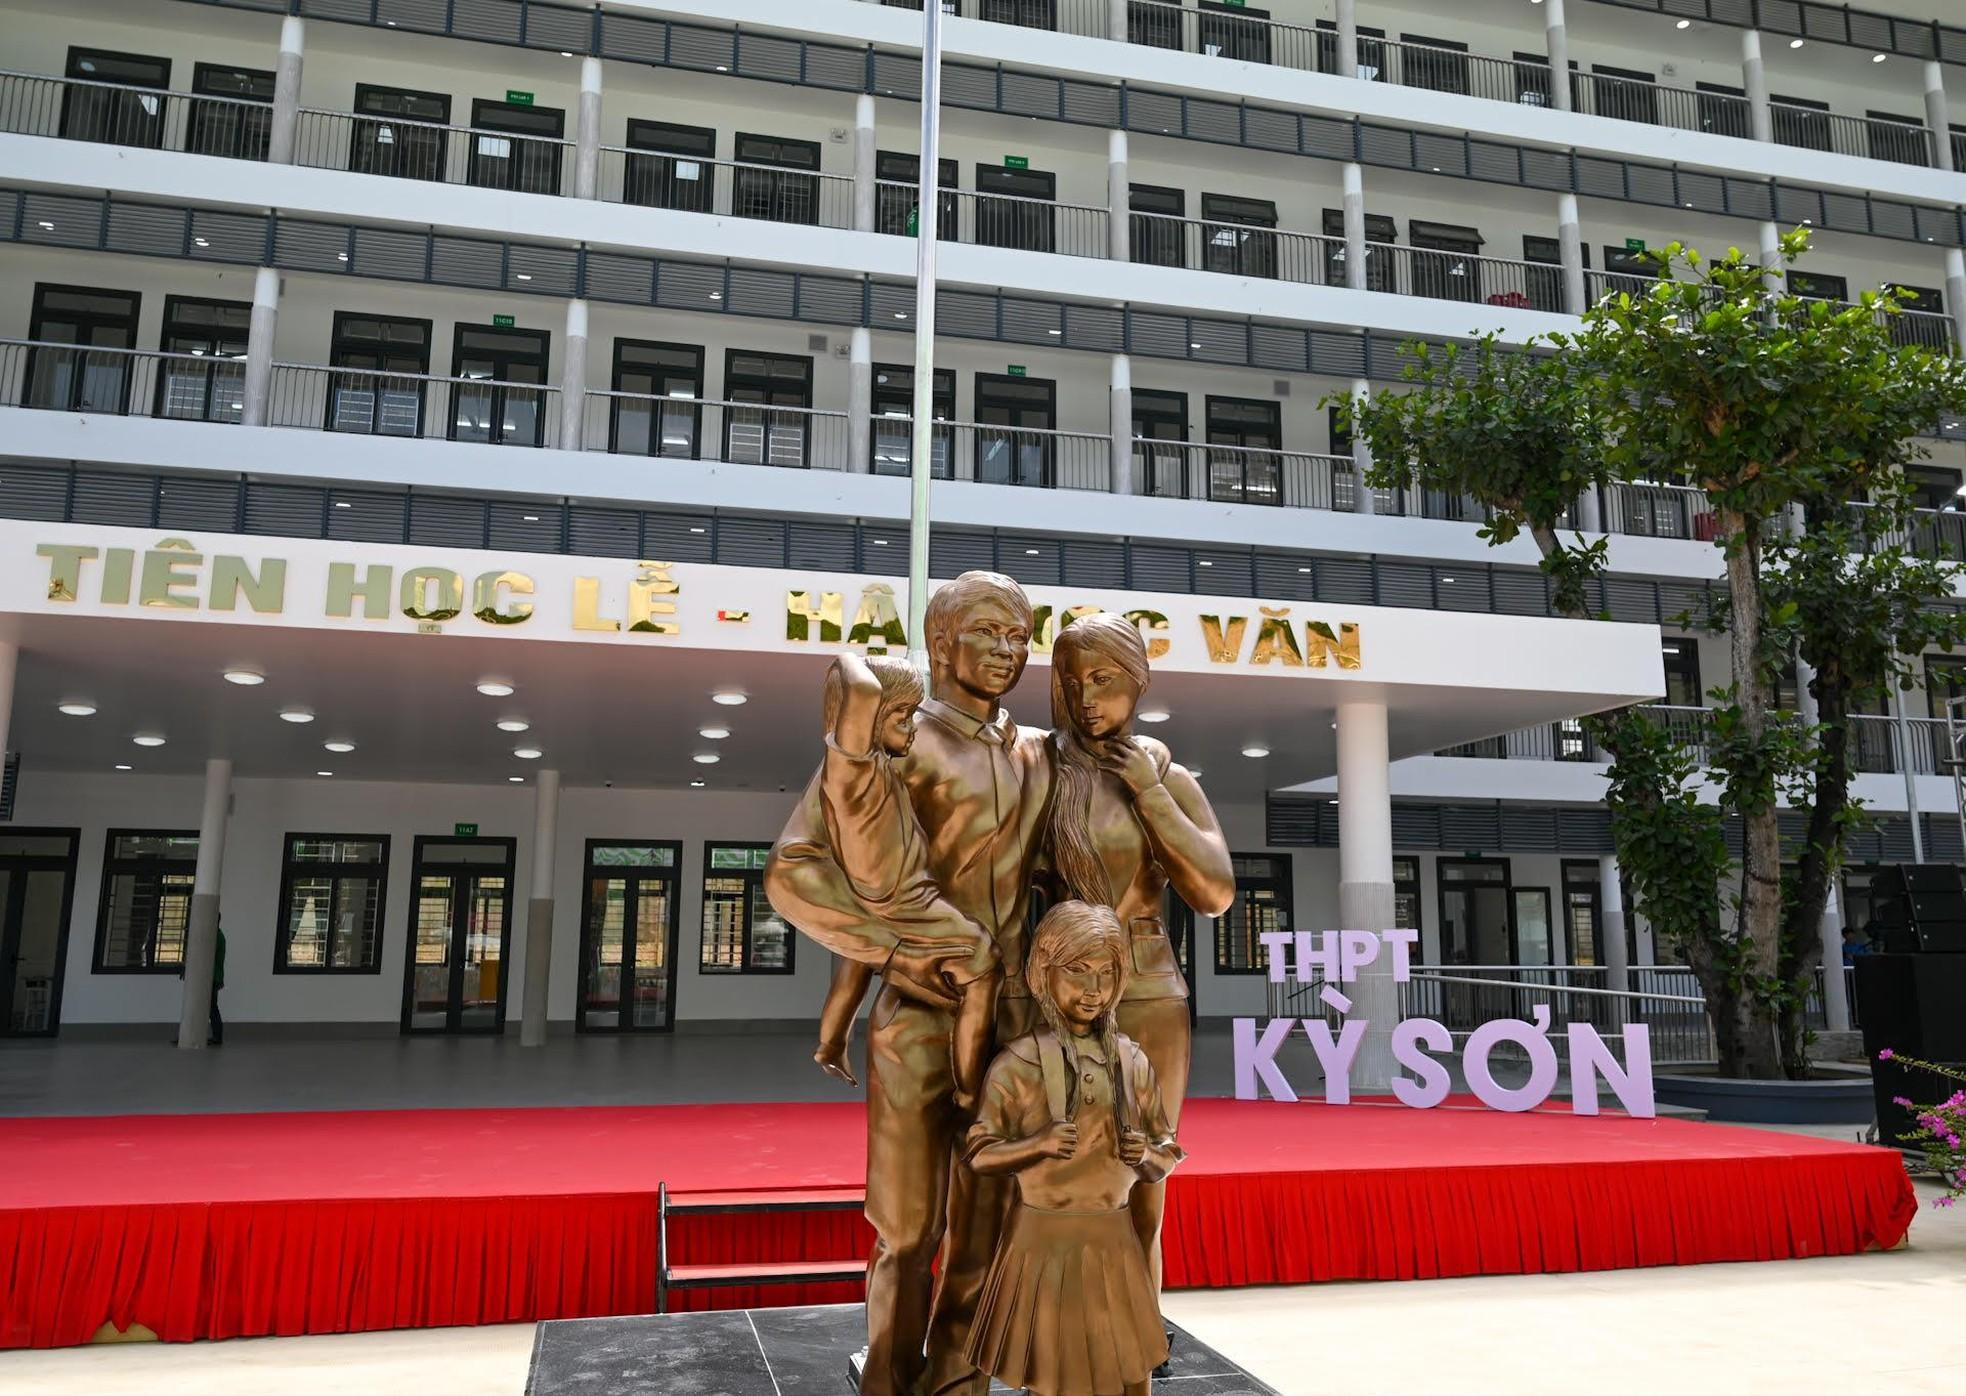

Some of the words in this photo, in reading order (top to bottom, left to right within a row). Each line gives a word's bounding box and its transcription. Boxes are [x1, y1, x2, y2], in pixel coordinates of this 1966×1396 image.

[36, 537, 287, 614] TIÊN
[325, 561, 535, 634] HỌC
[571, 560, 681, 635] LỄ
[717, 608, 749, 622] -
[786, 582, 908, 656] HẬ
[1199, 606, 1362, 670] VĂN
[1259, 928, 1418, 983] THPT
[1232, 984, 1370, 1105] KỲ
[1390, 1003, 1656, 1119] SƠN
